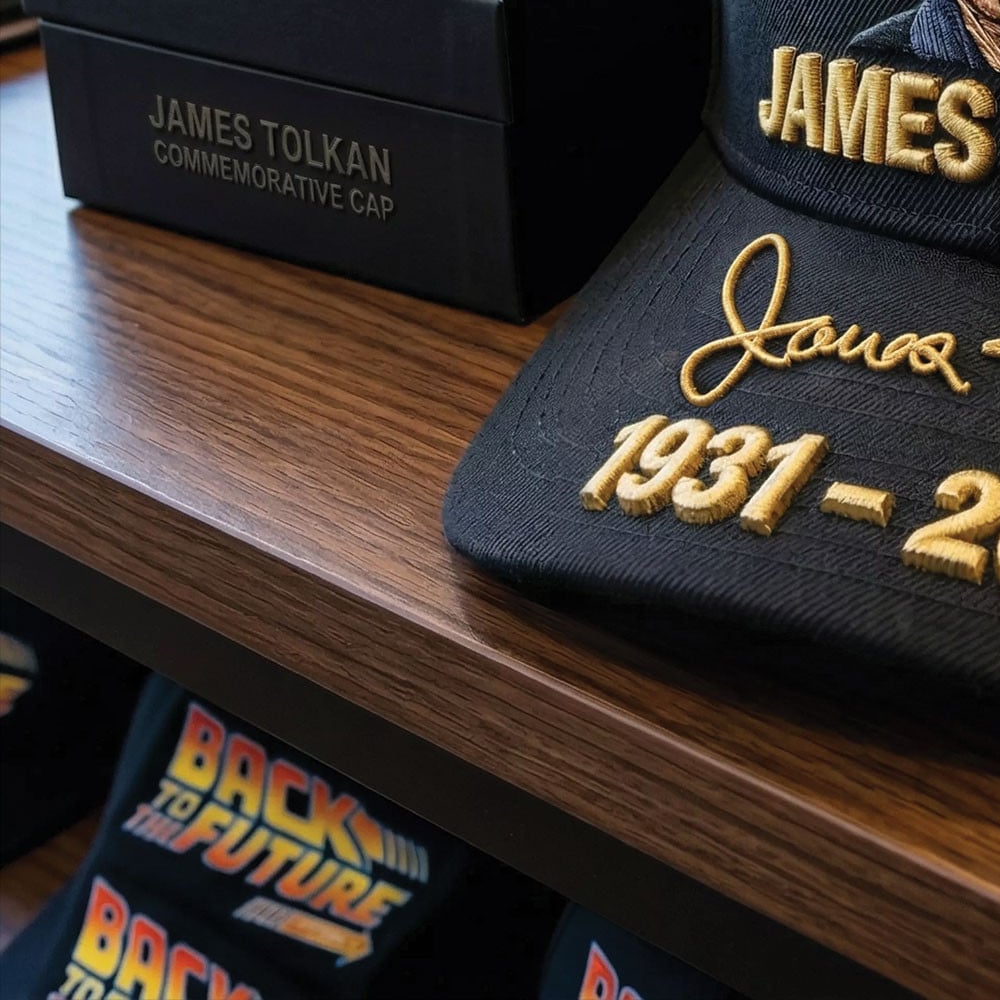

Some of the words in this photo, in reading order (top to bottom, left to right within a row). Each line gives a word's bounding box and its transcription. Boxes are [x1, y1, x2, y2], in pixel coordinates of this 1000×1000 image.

[148, 94, 252, 150] JAMES
[259, 118, 392, 185] TOLKAN
[758, 46, 997, 183] JAMES
[153, 139, 344, 209] COMMEMORATIVE
[350, 187, 394, 221] CAP
[578, 413, 829, 536] 1931
[151, 778, 203, 820] TO
[168, 701, 369, 873] BACK
[170, 801, 414, 930] FUTURE
